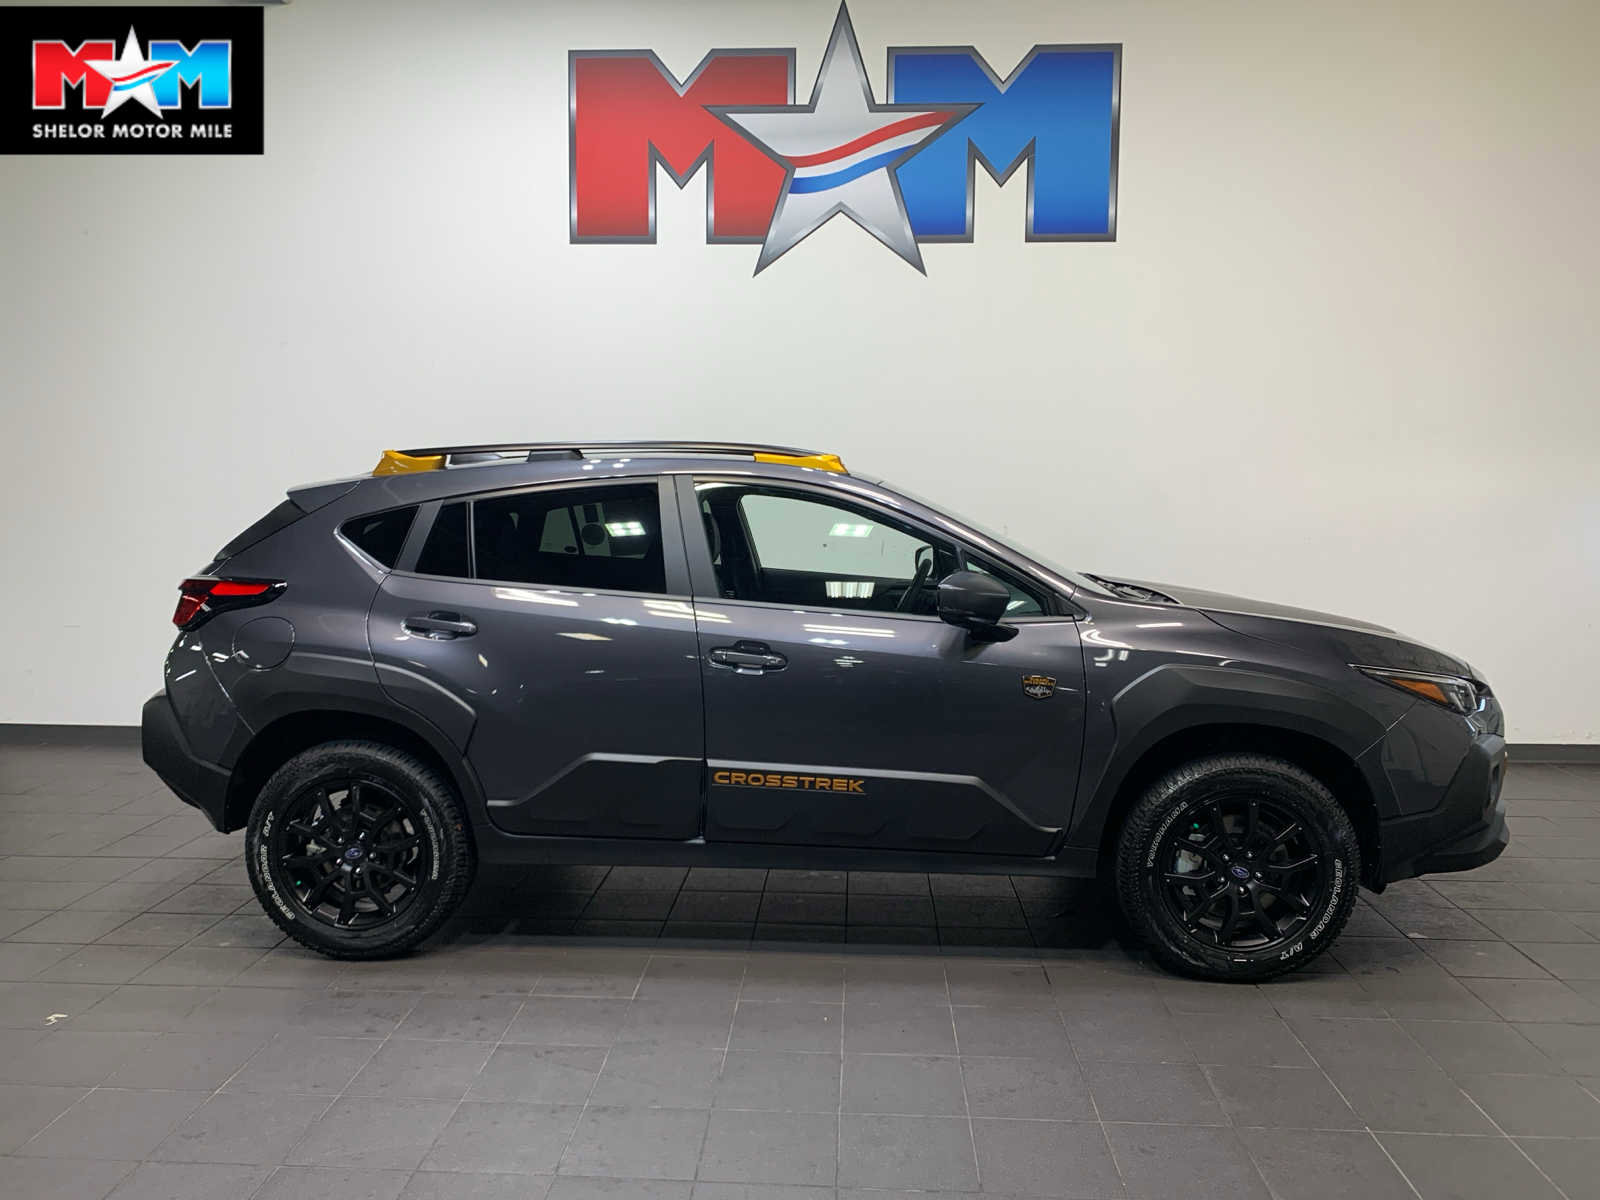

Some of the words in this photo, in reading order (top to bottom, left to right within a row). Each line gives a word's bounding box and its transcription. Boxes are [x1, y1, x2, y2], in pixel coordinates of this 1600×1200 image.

[713, 771, 865, 792] CROSSTREK
[1310, 859, 1343, 939] GEOLANDAR
[1280, 942, 1303, 961] A/T
